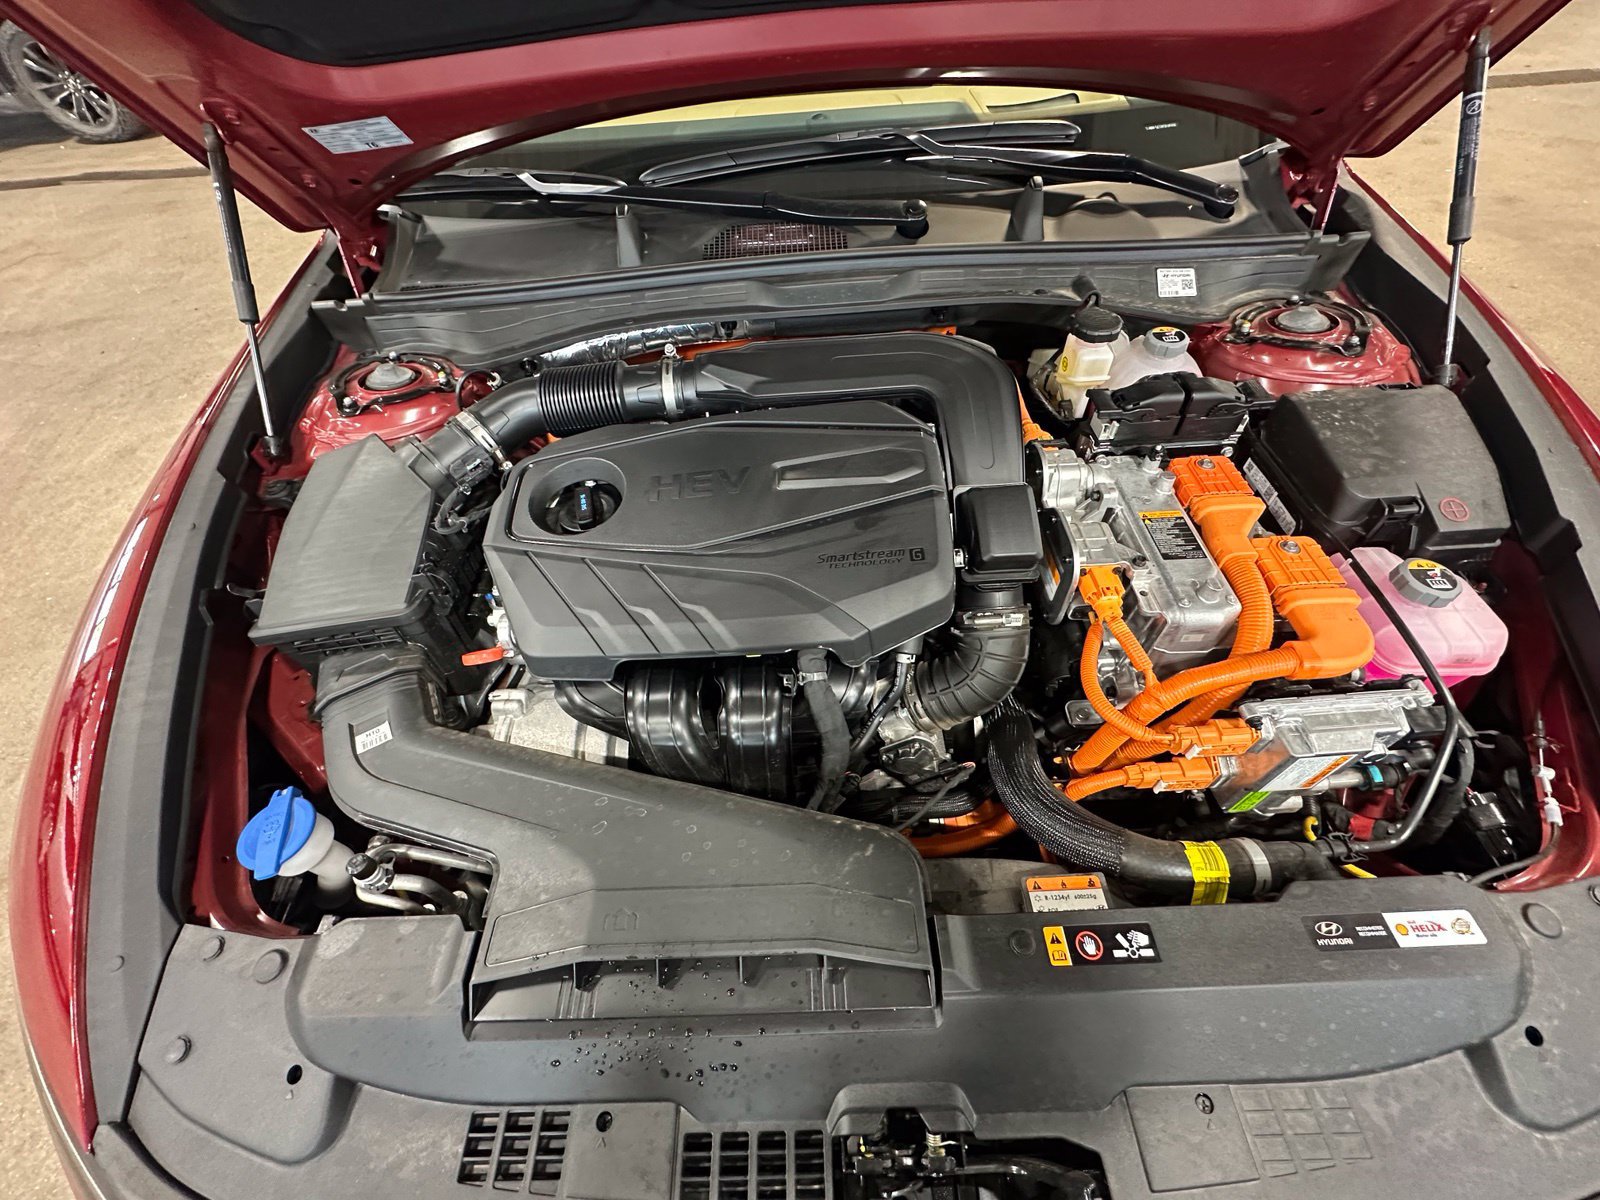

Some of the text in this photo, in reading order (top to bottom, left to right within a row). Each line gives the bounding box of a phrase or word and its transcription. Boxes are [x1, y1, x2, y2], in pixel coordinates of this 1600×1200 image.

[649, 466, 750, 502] HEV
[817, 548, 924, 564] Smartstream G
[829, 558, 904, 568] TECHNOLOGY
[1411, 922, 1448, 933] HELIX
[1317, 938, 1354, 946] HYUNDAI
